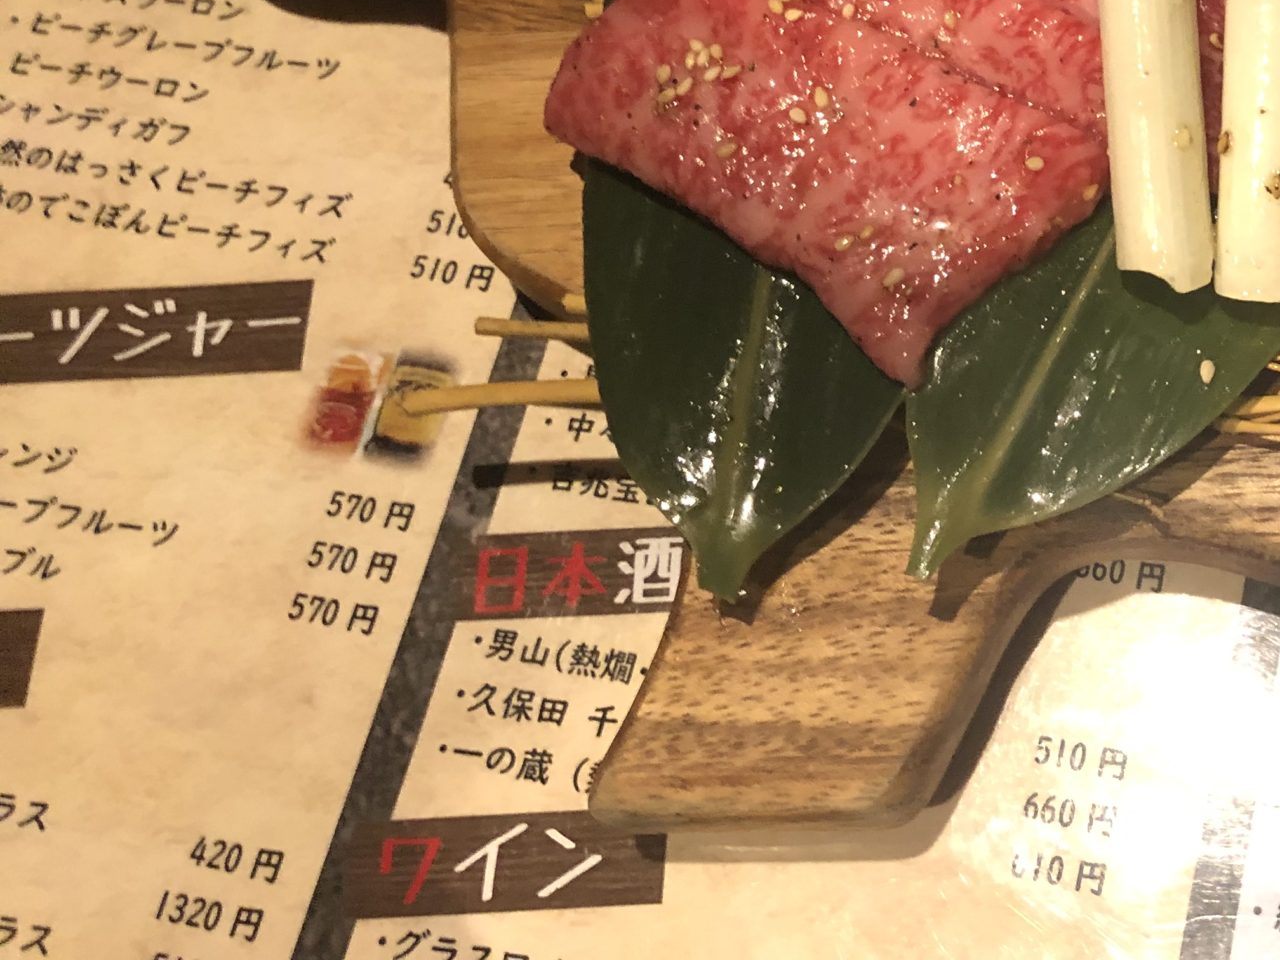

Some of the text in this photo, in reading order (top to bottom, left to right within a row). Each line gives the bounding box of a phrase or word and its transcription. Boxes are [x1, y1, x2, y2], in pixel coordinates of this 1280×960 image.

[410, 255, 495, 292] 510 円
[326, 492, 416, 532] 570 円
[306, 541, 398, 584] 570 円
[472, 536, 685, 615] 日本酒
[1135, 561, 1166, 593] 円
[287, 593, 380, 636] 570 円
[1034, 735, 1128, 781] 510 円
[1022, 792, 1075, 828] 660
[190, 836, 285, 884] 420 円
[378, 823, 603, 905] ワイン
[1075, 860, 1107, 897] 円
[156, 890, 264, 942] 1320 円
